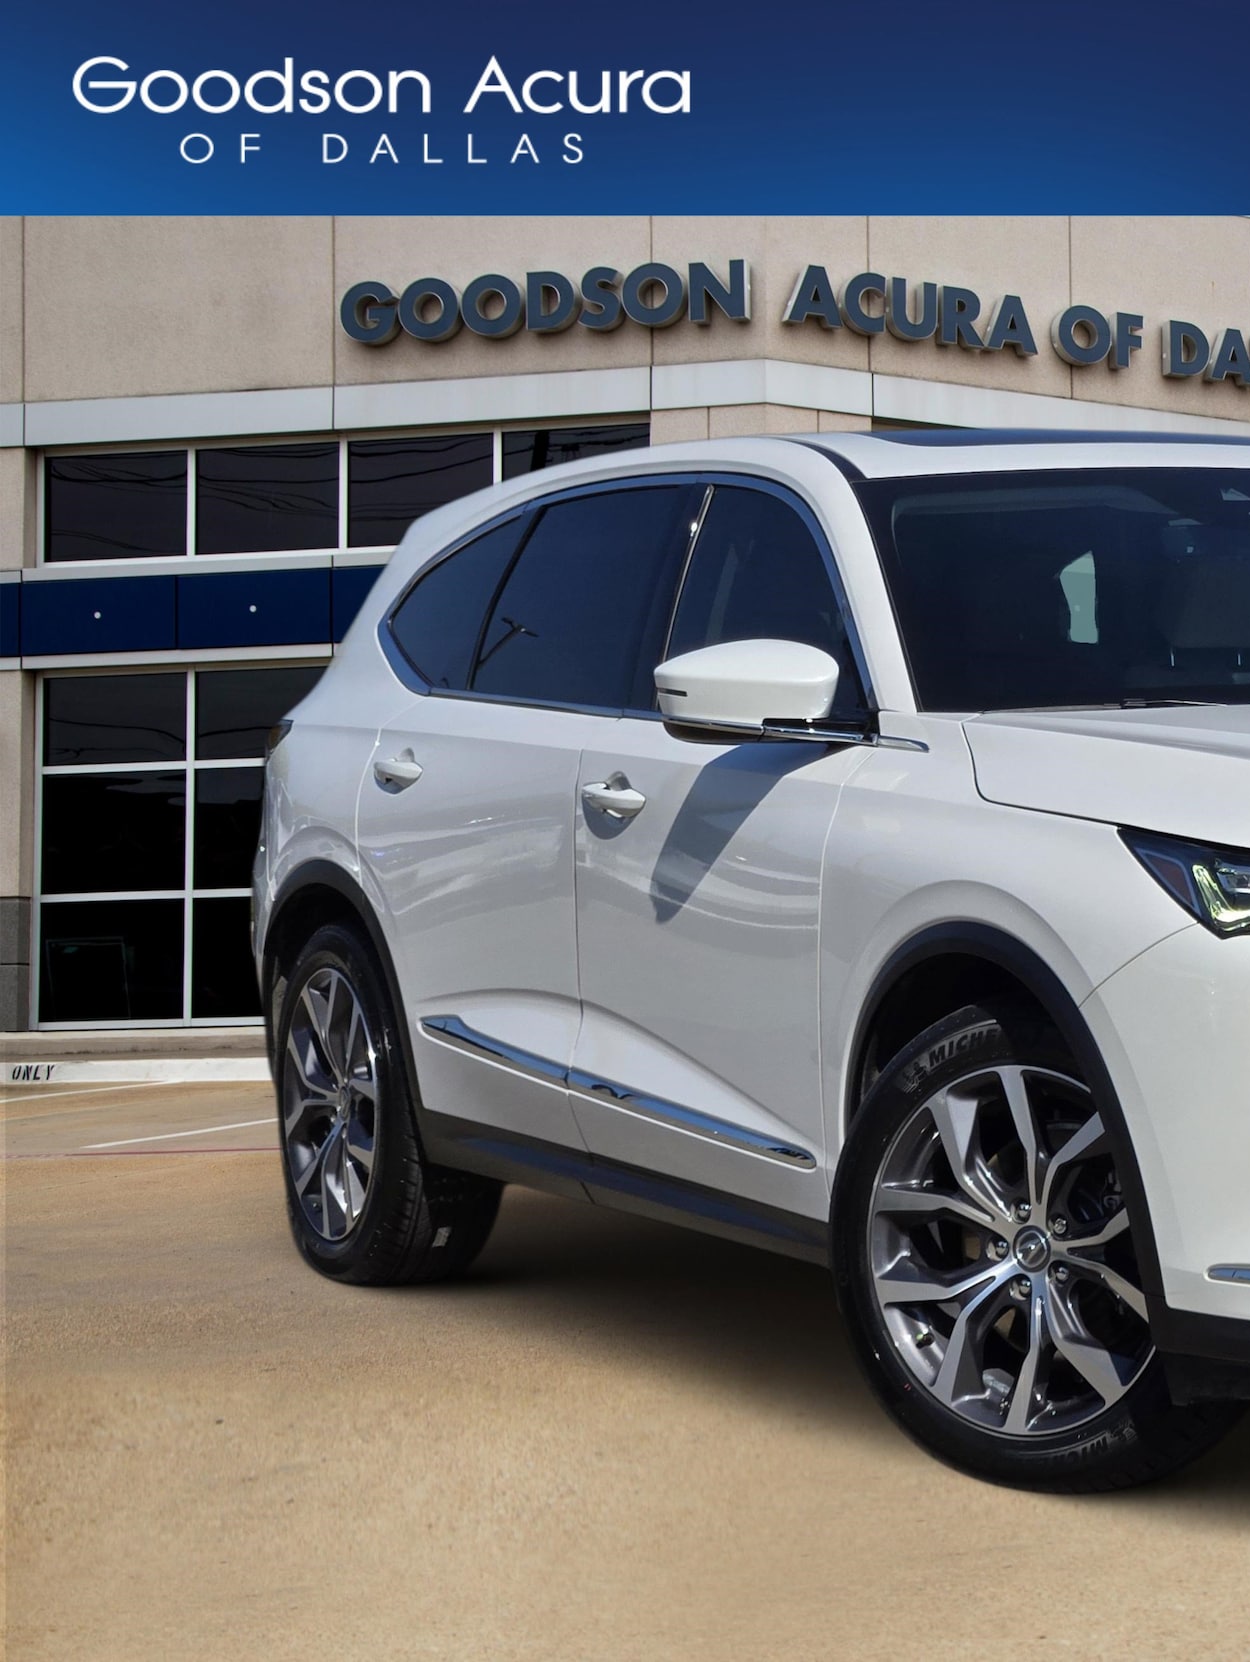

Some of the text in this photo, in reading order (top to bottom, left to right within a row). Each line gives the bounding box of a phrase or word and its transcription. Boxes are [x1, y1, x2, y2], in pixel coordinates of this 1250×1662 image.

[340, 259, 751, 346] GOODSON
[783, 264, 1038, 357] ACURA
[1050, 305, 1144, 369] OF
[12, 1064, 55, 1081] ONLY
